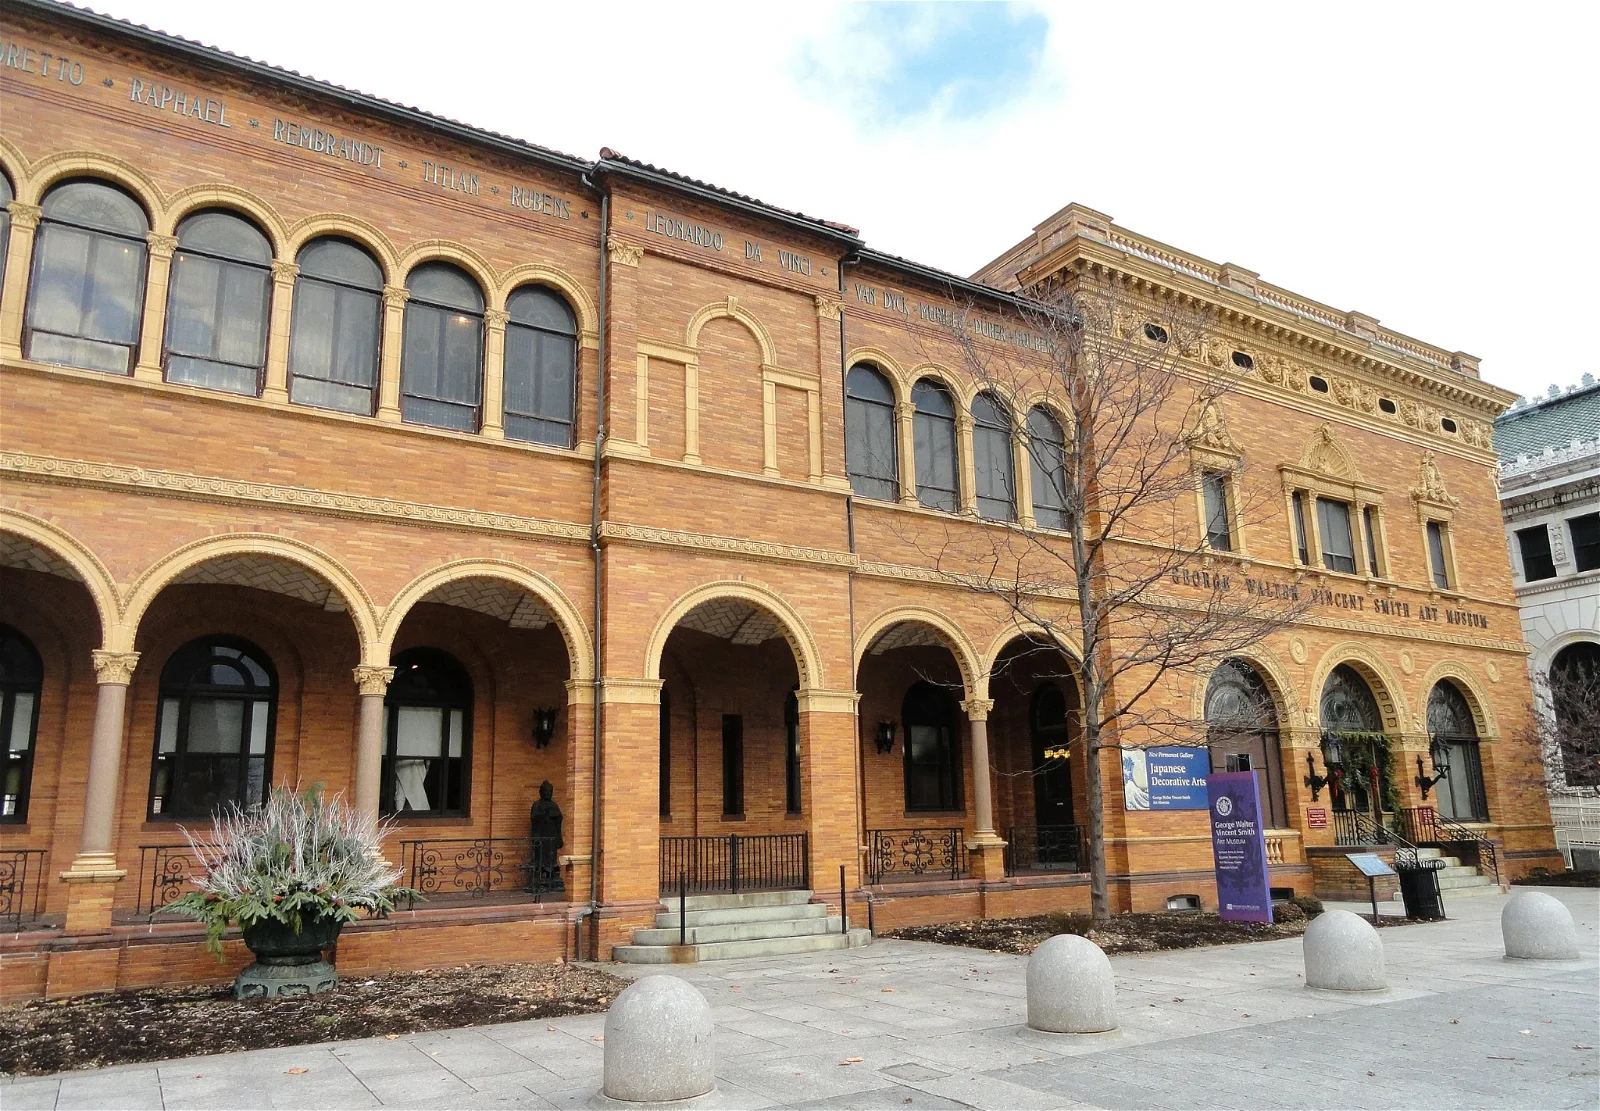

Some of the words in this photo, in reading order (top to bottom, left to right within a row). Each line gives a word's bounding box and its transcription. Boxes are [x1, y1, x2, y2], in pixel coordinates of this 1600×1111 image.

[130, 77, 232, 128] RAPHAEL
[273, 117, 385, 169] REMBRANDT
[422, 159, 480, 196] TITIAN
[510, 184, 572, 220] RUBENS
[645, 211, 724, 251] LEONARDO
[744, 240, 763, 263] DA
[778, 249, 812, 276] VINCI
[854, 283, 877, 306] VAN
[883, 291, 910, 315] DYCK
[1310, 588, 1365, 611] VINCENT
[1374, 598, 1410, 618] SMITH
[1418, 605, 1438, 622] ART
[1445, 609, 1488, 629] MUSEUM
[1150, 762, 1186, 776] Japanese
[1151, 776, 1191, 786] Decorative
[1191, 777, 1207, 787] Arts
[1214, 821, 1235, 830] George
[1235, 820, 1255, 828] Walter
[1237, 828, 1255, 836] Smith
